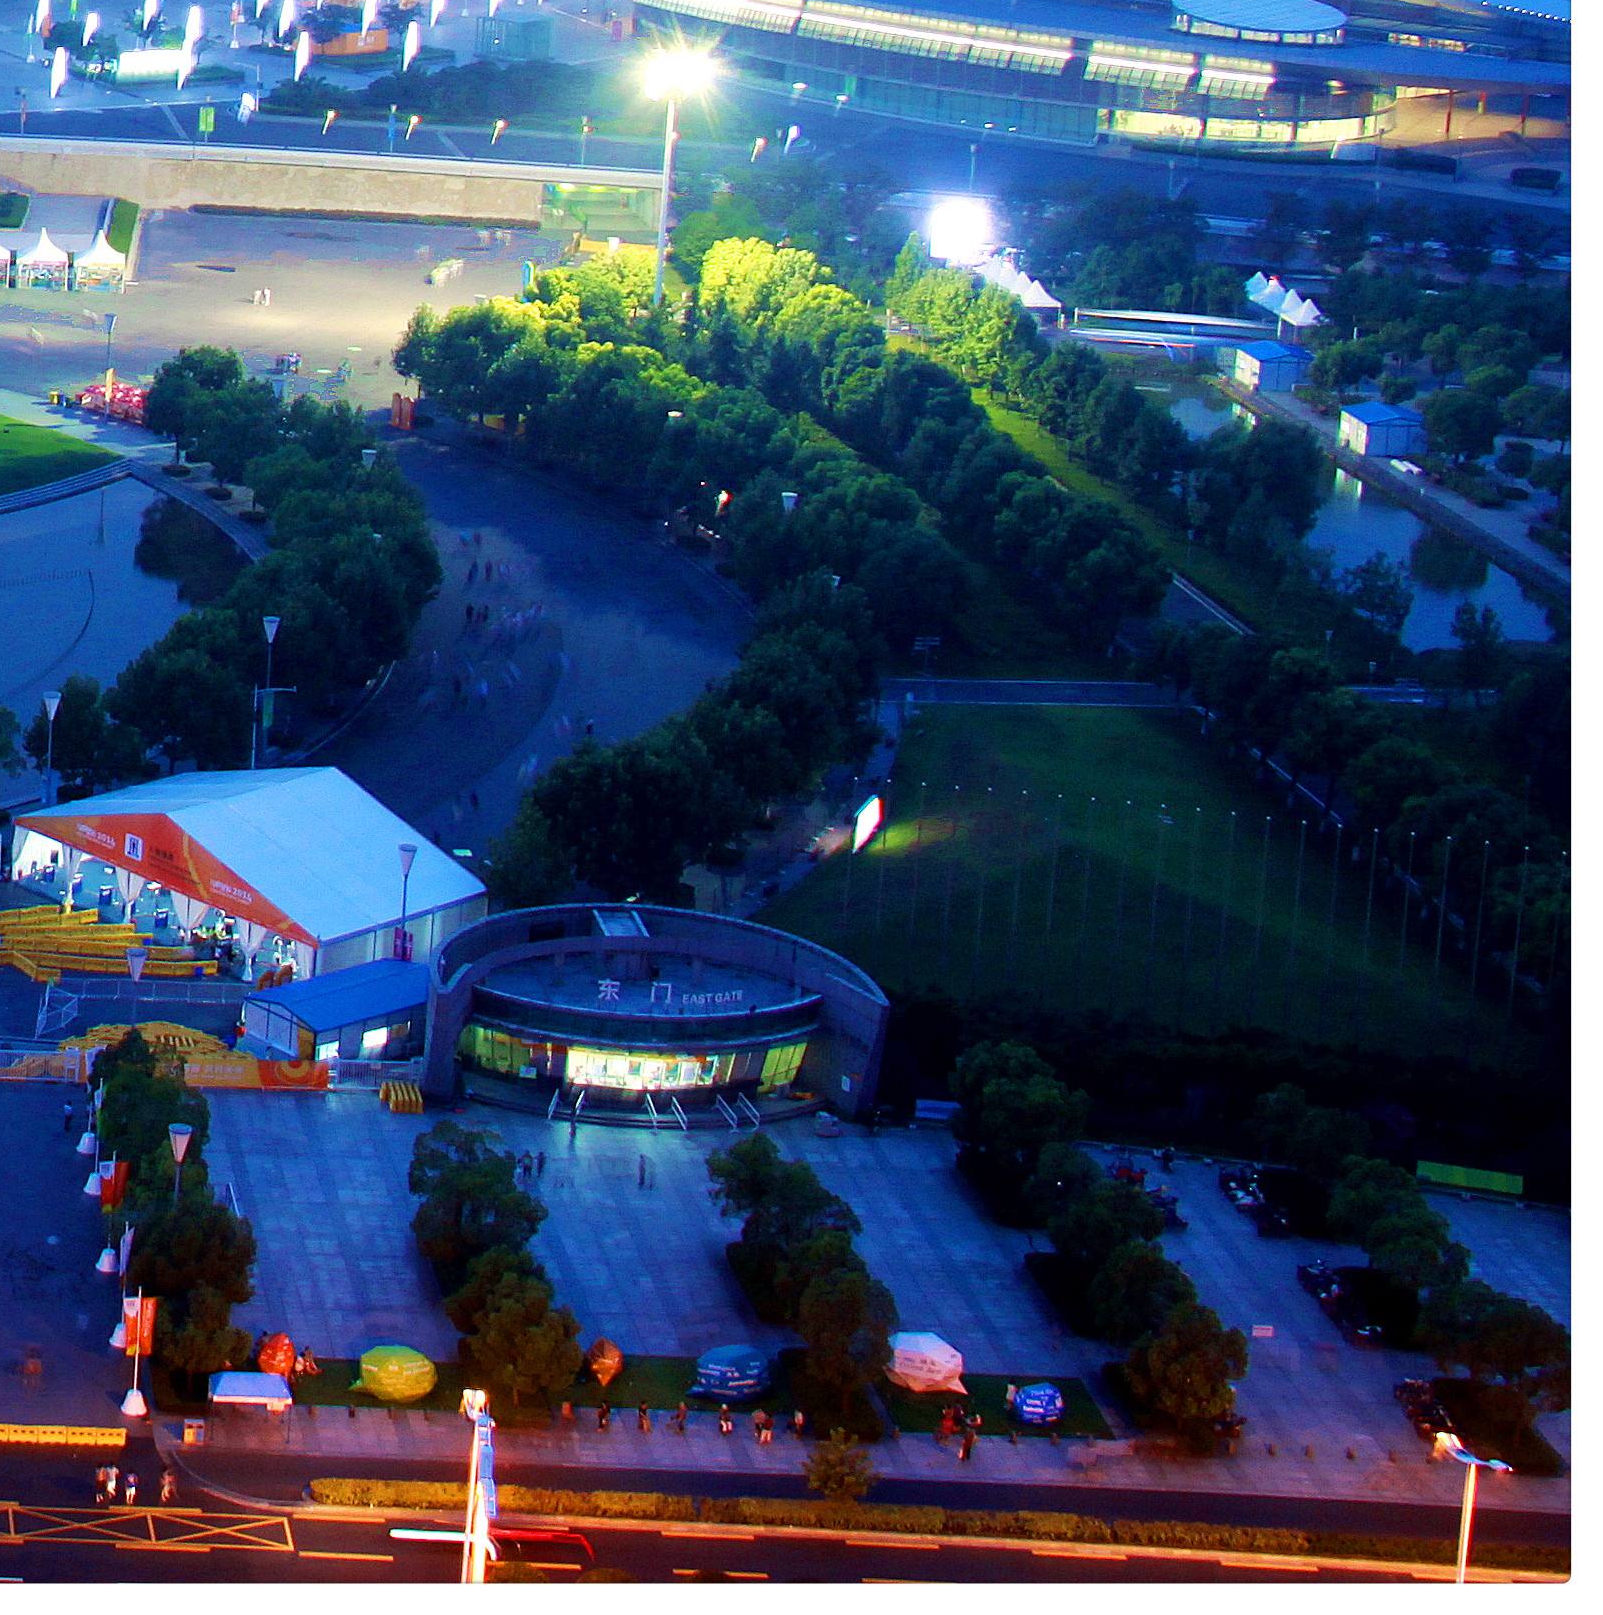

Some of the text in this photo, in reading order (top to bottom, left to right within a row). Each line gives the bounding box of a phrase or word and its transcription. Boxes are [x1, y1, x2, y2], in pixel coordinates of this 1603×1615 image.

[597, 978, 672, 1004] 东门
[682, 990, 743, 1005] EAST GATE
